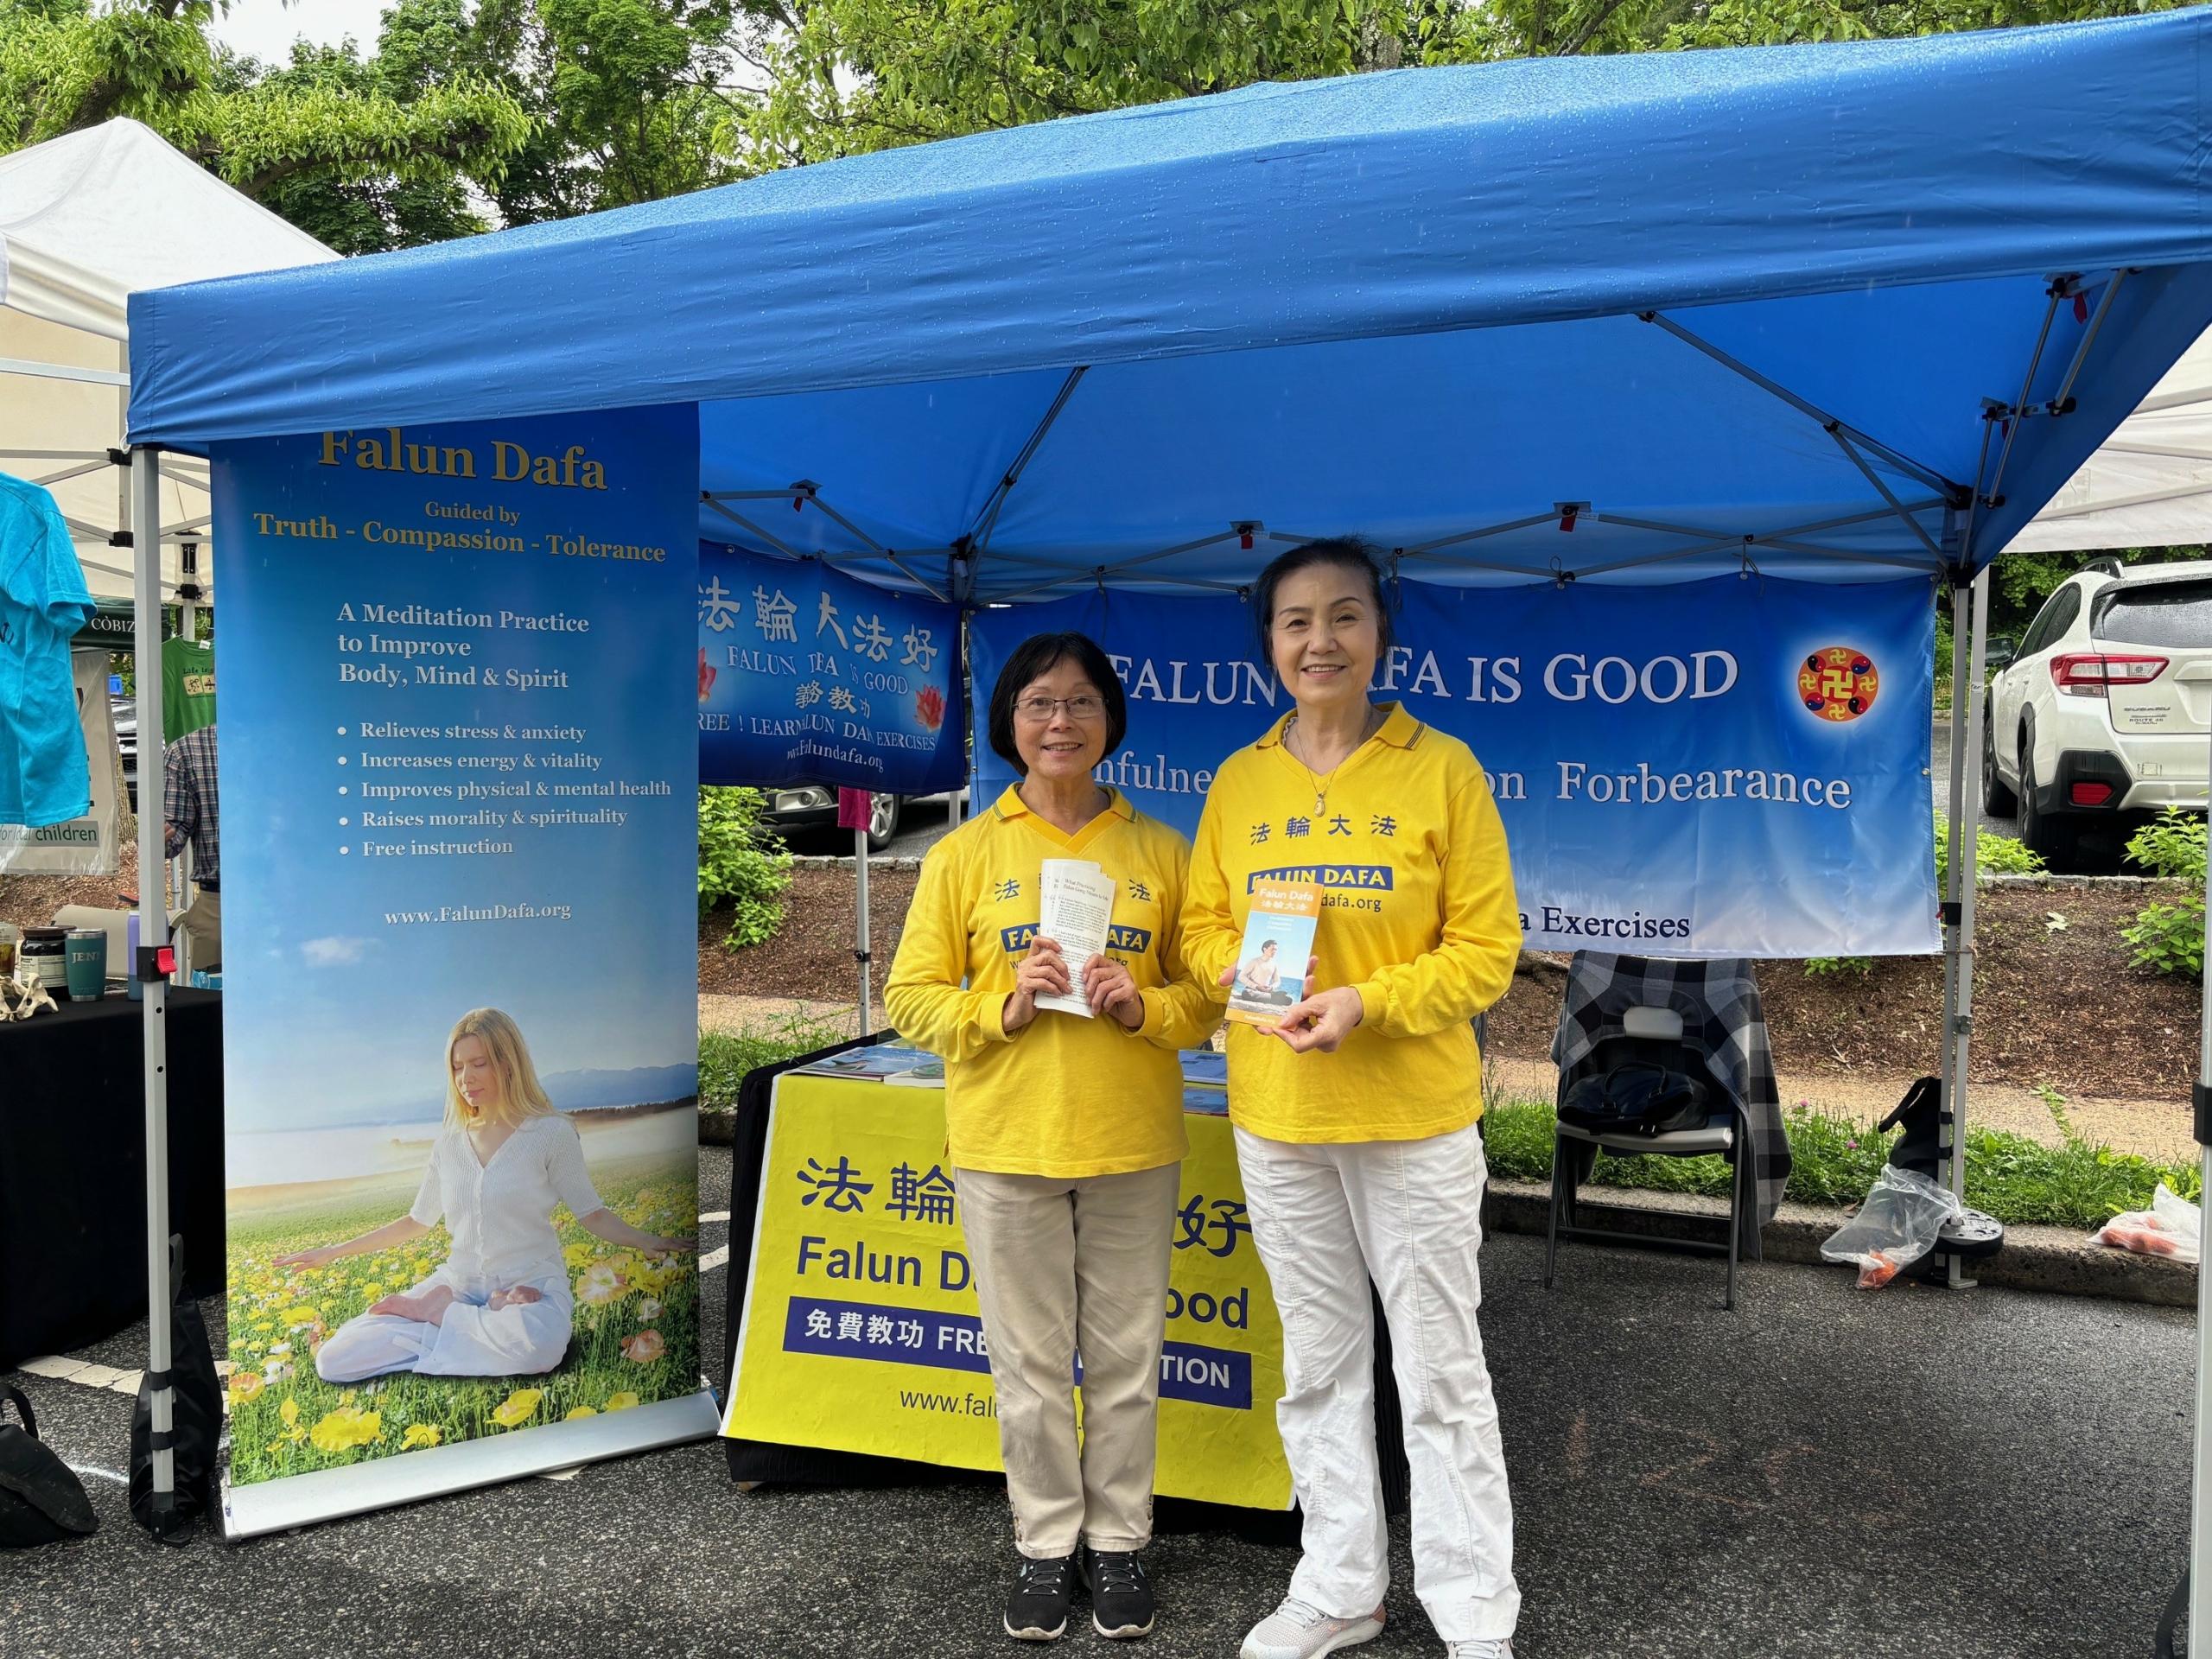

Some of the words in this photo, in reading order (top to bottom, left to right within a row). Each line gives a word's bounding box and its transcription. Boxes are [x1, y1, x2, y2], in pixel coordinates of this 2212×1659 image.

[318, 429, 477, 479] Falun
[491, 441, 607, 489] Dafa
[425, 501, 493, 522] Guided
[499, 505, 520, 525] by
[253, 512, 338, 539] Truth
[363, 520, 524, 552] Compassion
[545, 534, 666, 563] Tolerance
[337, 602, 354, 621] A
[362, 604, 493, 629] Meditation
[499, 610, 589, 632] Practice
[698, 575, 938, 671] 法輪大法好
[338, 635, 362, 652] to
[370, 634, 471, 658] Improve
[339, 663, 408, 688] Body,
[415, 664, 477, 685] Mind
[482, 667, 500, 686] &
[505, 668, 569, 691] Spirit
[727, 645, 797, 676] FALUN
[864, 671, 908, 695] GOOD
[1106, 654, 1278, 707] FALUN
[1466, 657, 1522, 703] IS
[1543, 650, 1738, 704] GOOD
[360, 722, 440, 739] Relieves
[445, 725, 499, 740] stress
[503, 725, 518, 740] &
[521, 725, 587, 743] anxiety
[698, 713, 730, 731] REE
[876, 731, 936, 751] EXERCISES
[361, 753, 452, 768] Increases
[457, 757, 518, 771] energy
[523, 753, 537, 768] &
[541, 752, 602, 771] vitality
[361, 781, 452, 800] Improves
[457, 780, 531, 801] physical
[535, 781, 550, 796] &
[554, 780, 615, 796] mental
[620, 780, 671, 796] health
[1556, 761, 1853, 809] Forbearance
[35, 824, 97, 841] children
[362, 810, 423, 827] Raises
[429, 809, 508, 828] morality
[512, 810, 526, 825] &
[530, 809, 628, 828] spirituality
[1250, 814, 1397, 846] 法輪大法
[363, 841, 406, 856] Free
[410, 839, 513, 856] instruction
[1324, 868, 1386, 887] DAFA
[1259, 887, 1287, 899] Falun
[1289, 890, 1313, 901] Dafa
[1321, 893, 1382, 912] dafa.org
[385, 902, 572, 925] www.FalunDafa.org
[1541, 906, 1690, 938] Exercises
[1106, 928, 1143, 950] AFA
[797, 1236, 922, 1287] Falun
[1166, 1287, 1249, 1330] ood
[805, 1308, 925, 1349] 免費教功
[938, 1326, 988, 1357] FRE
